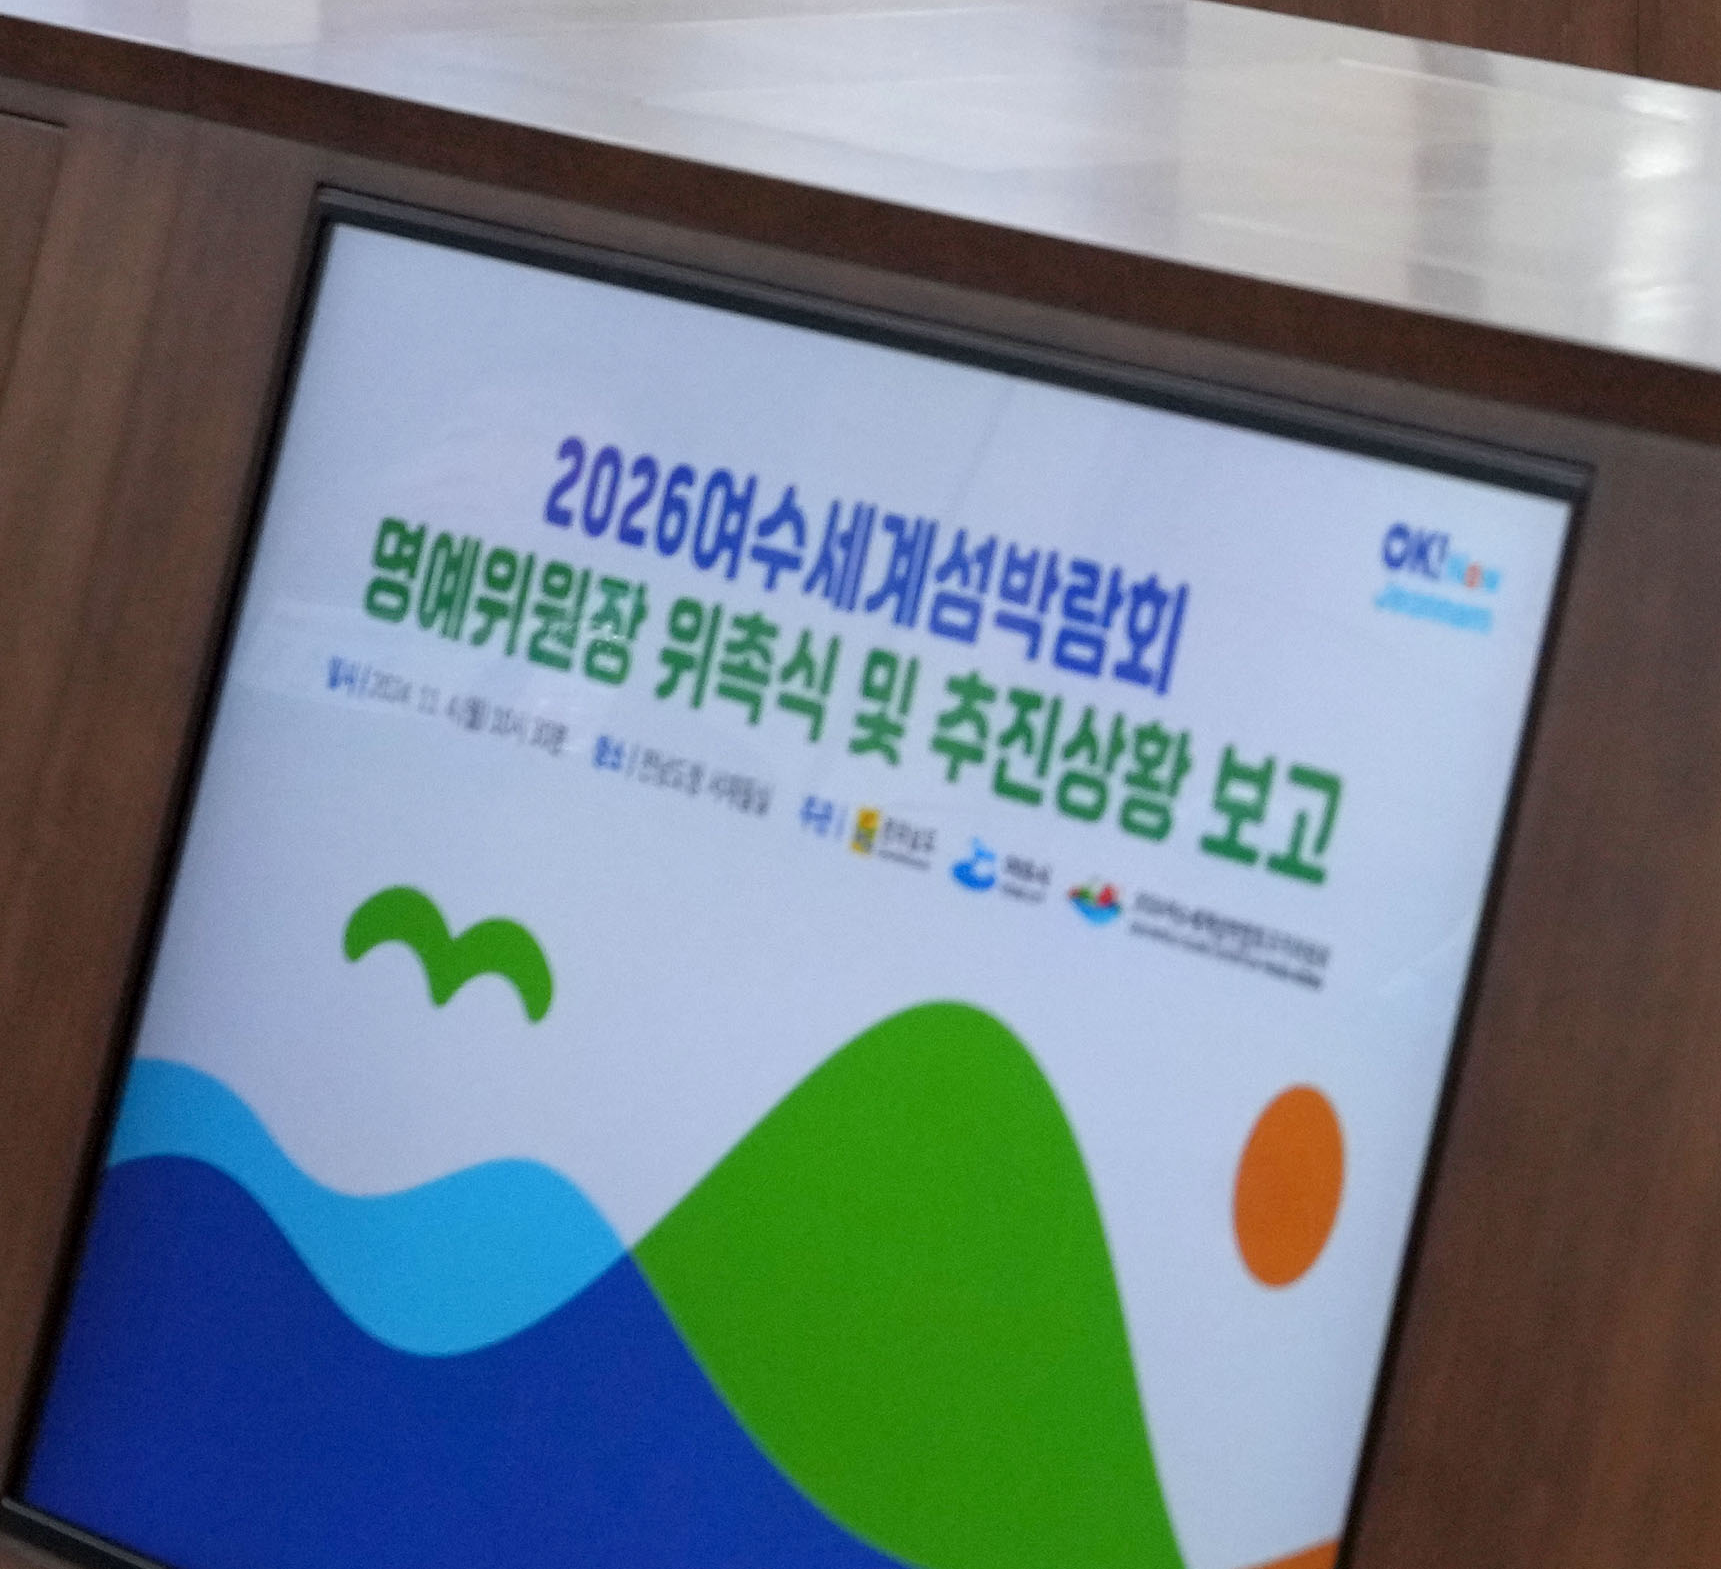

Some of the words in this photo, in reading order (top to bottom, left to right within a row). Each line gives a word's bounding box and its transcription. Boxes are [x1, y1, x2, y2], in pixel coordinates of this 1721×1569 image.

[363, 515, 650, 687] 명예위원장
[652, 596, 842, 745] 위촉식
[848, 645, 920, 768] 및
[928, 668, 1193, 846] 추진상황
[1199, 742, 1344, 887] 보고
[543, 434, 1189, 695] 2026여수세계섬박람회
